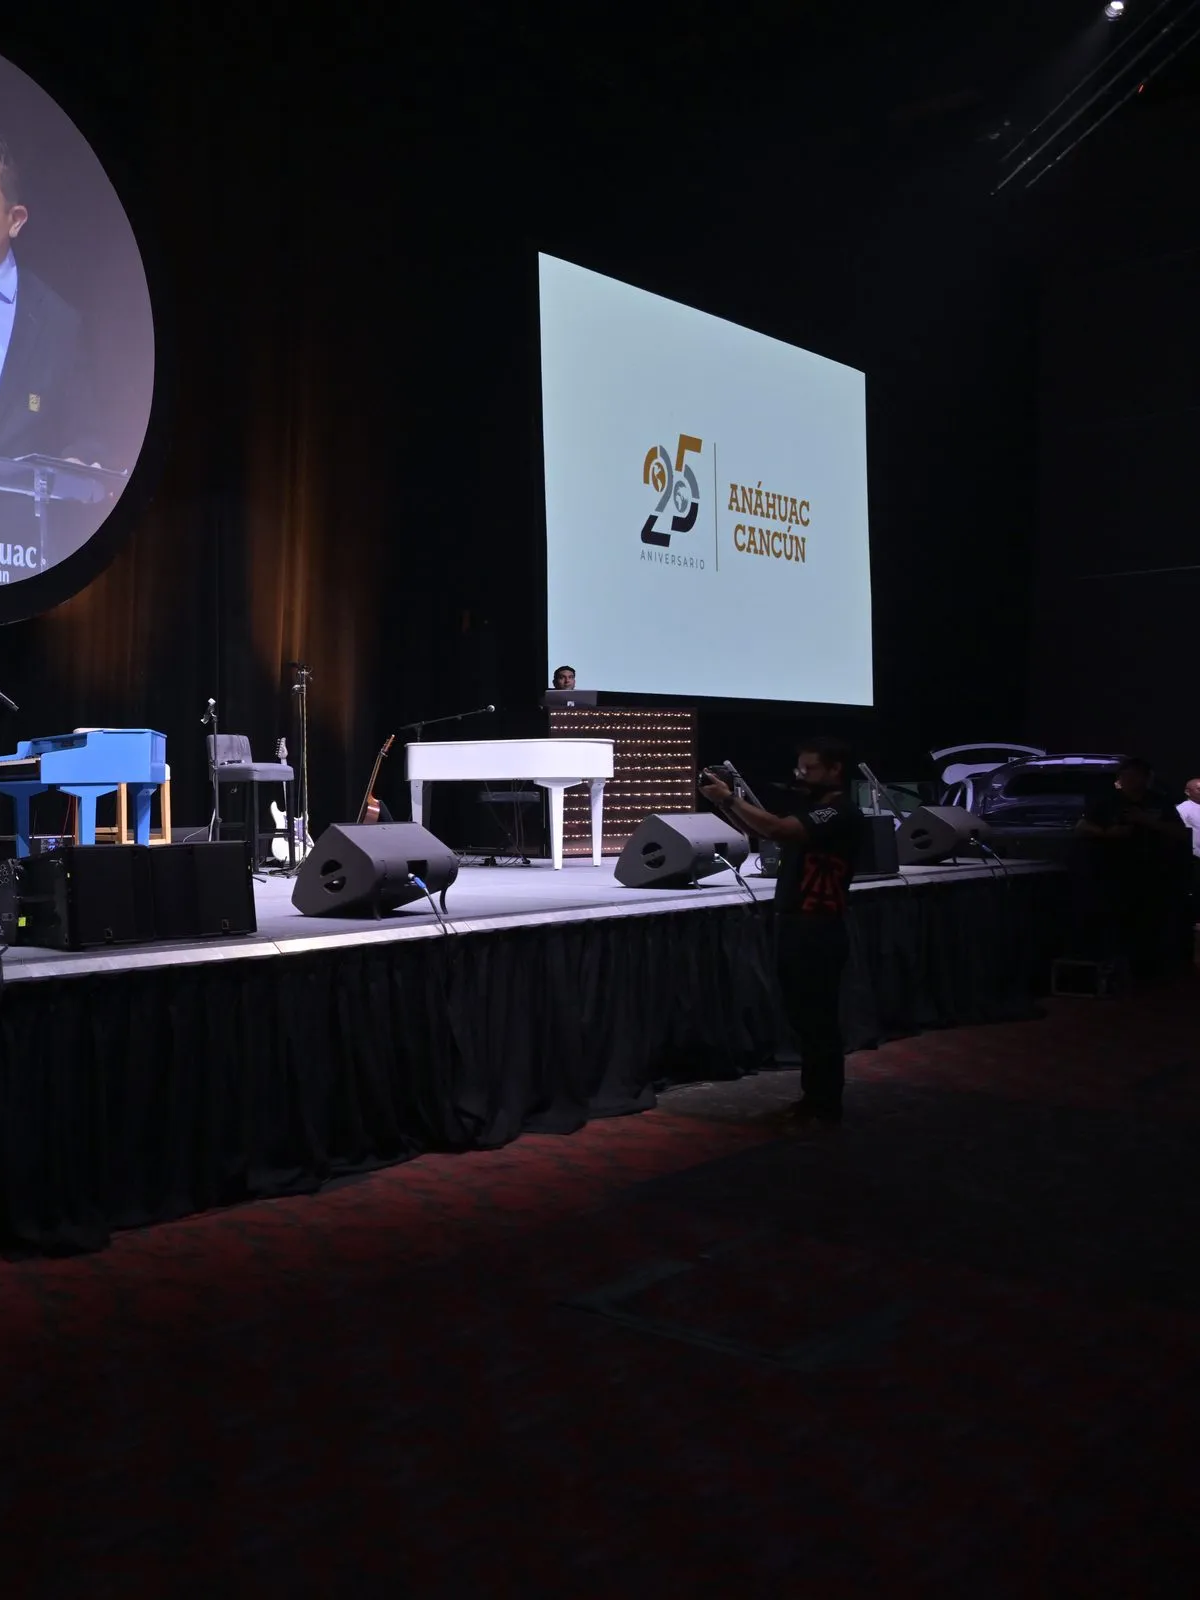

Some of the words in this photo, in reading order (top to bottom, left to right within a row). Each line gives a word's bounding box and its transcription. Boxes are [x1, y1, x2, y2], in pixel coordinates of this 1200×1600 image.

[727, 481, 810, 527] ANÁHUAC
[640, 549, 705, 570] ANIVERSARIO
[733, 526, 806, 563] CANCÚN
